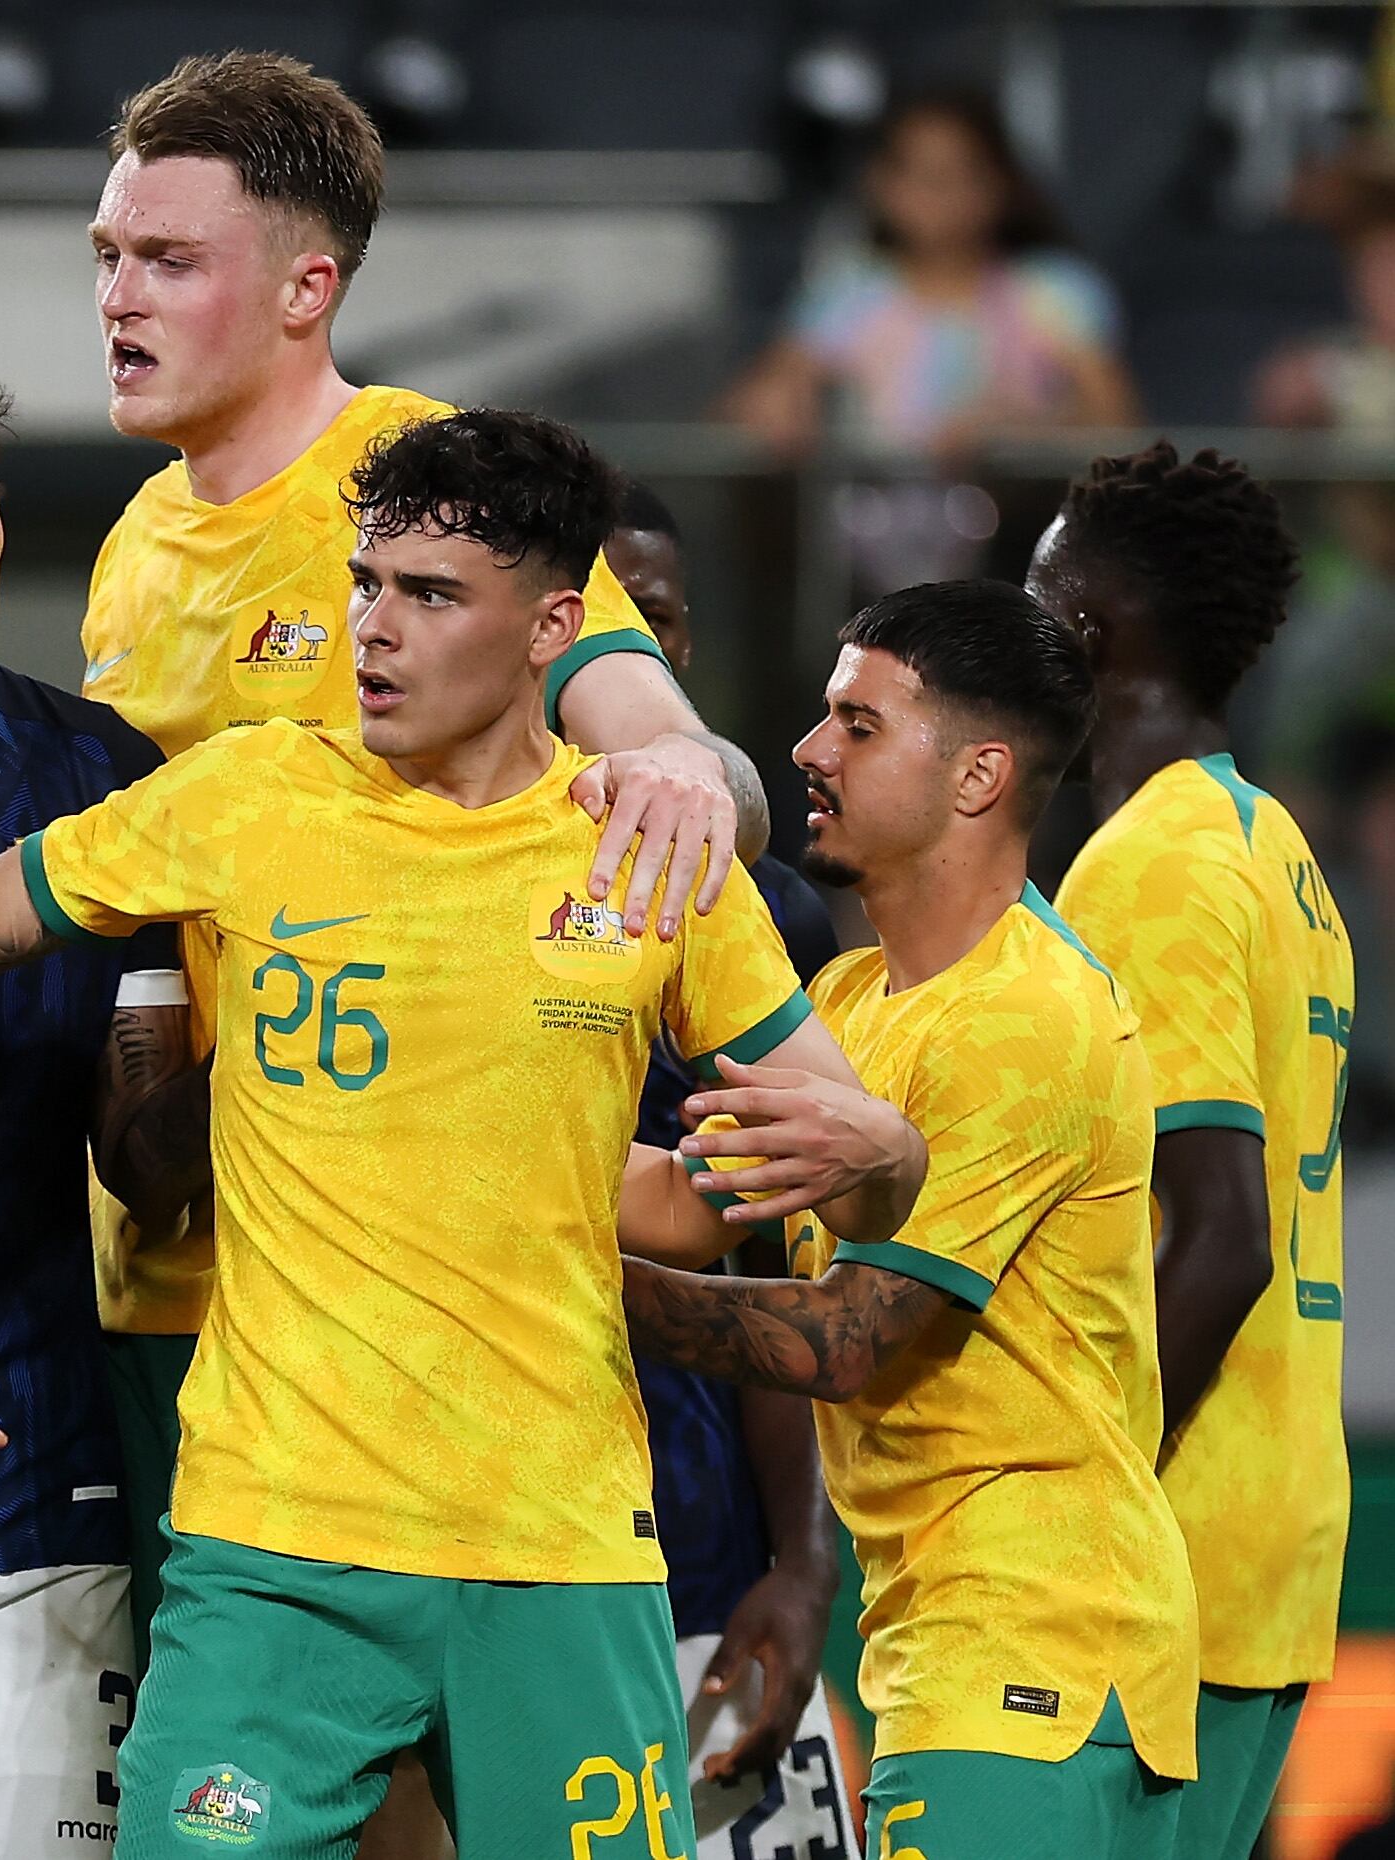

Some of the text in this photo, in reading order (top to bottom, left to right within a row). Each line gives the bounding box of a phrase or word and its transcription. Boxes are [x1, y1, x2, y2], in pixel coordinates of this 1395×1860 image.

[247, 662, 314, 674] AUSTRALIA
[552, 941, 627, 957] AUSTRALIA
[532, 998, 586, 1008] AUSTRALIA
[252, 952, 389, 1091] 26
[537, 1008, 571, 1019] FRIDAY
[573, 1011, 584, 1019] 24
[585, 1013, 613, 1025] MARCH
[541, 1019, 581, 1030] SYDNEY,
[96, 1669, 136, 1808] 3
[184, 1813, 249, 1835] AUSTRALIA
